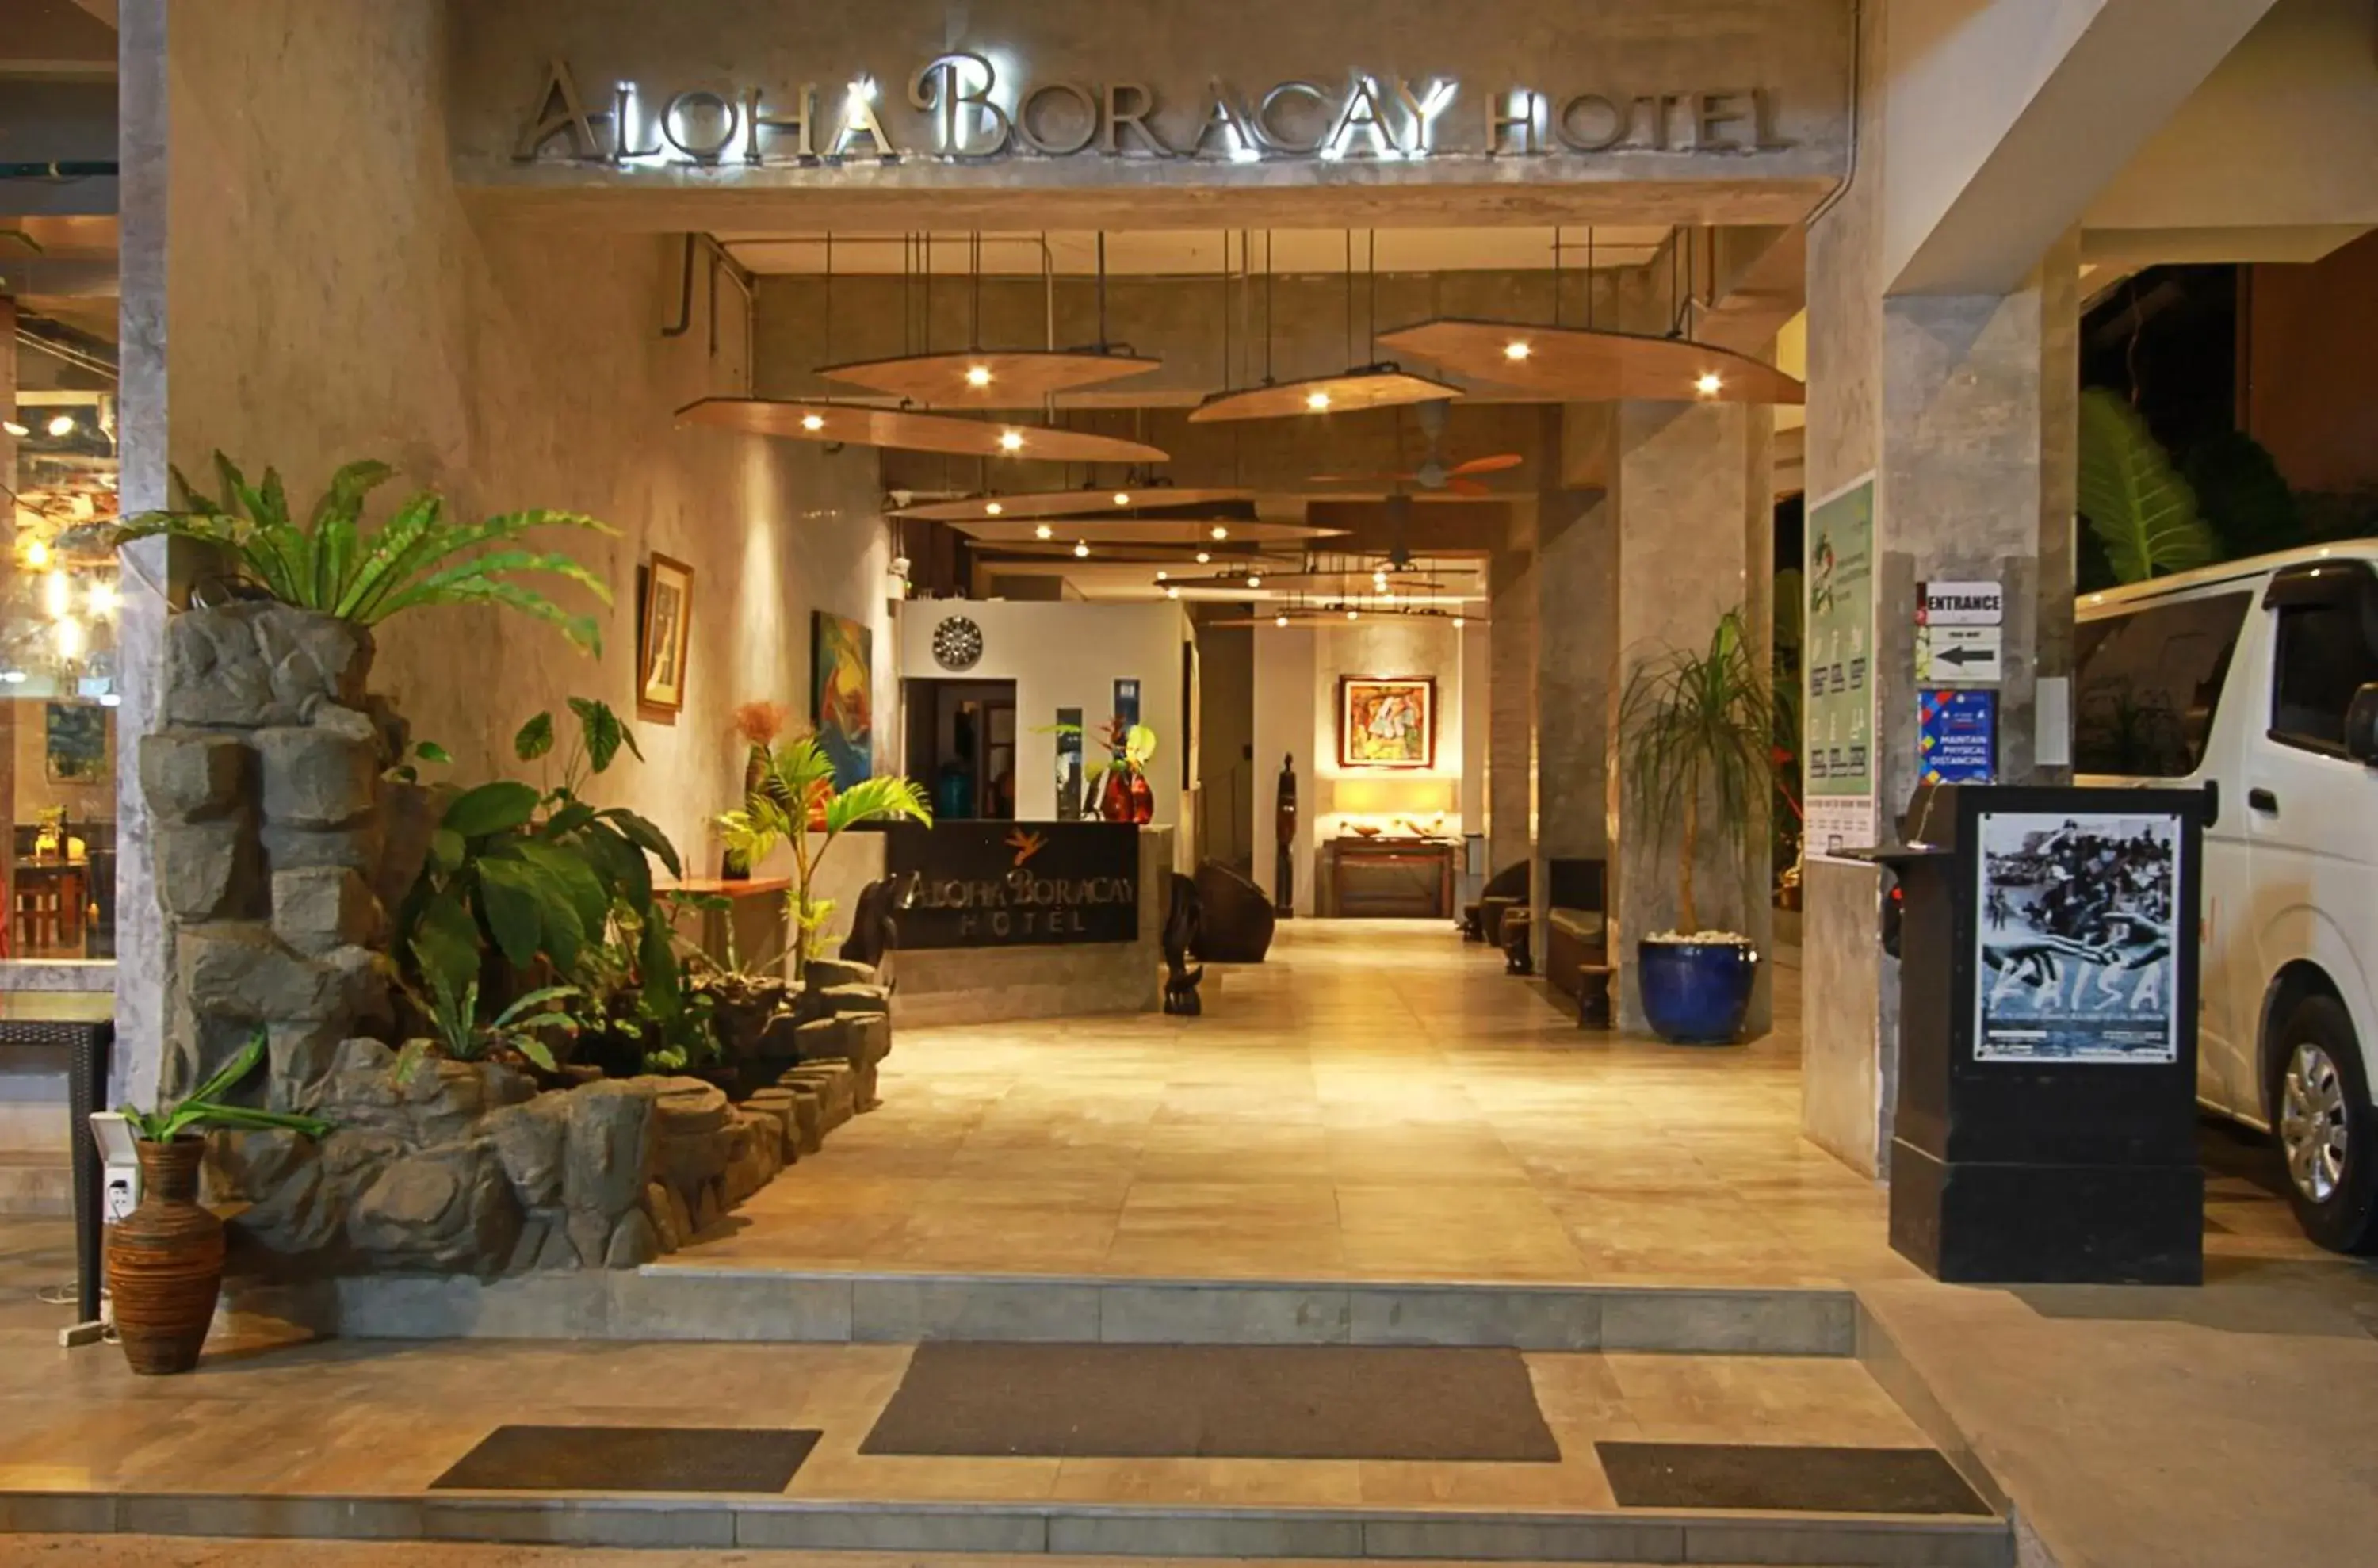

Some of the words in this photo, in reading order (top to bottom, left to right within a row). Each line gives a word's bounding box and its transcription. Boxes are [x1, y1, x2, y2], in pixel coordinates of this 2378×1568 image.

[517, 54, 902, 165] ALOHA
[908, 52, 1458, 162] BORACAY
[1485, 87, 1793, 159] HOTEL
[1928, 595, 2000, 610] ENTRANCE
[1940, 736, 1987, 744] MAINTAIN
[1943, 746, 1986, 755] PHYSICAL
[1929, 755, 1987, 765] DISTANCING
[1007, 869, 1134, 907] BORACAY
[961, 912, 1087, 937] HOTEL
